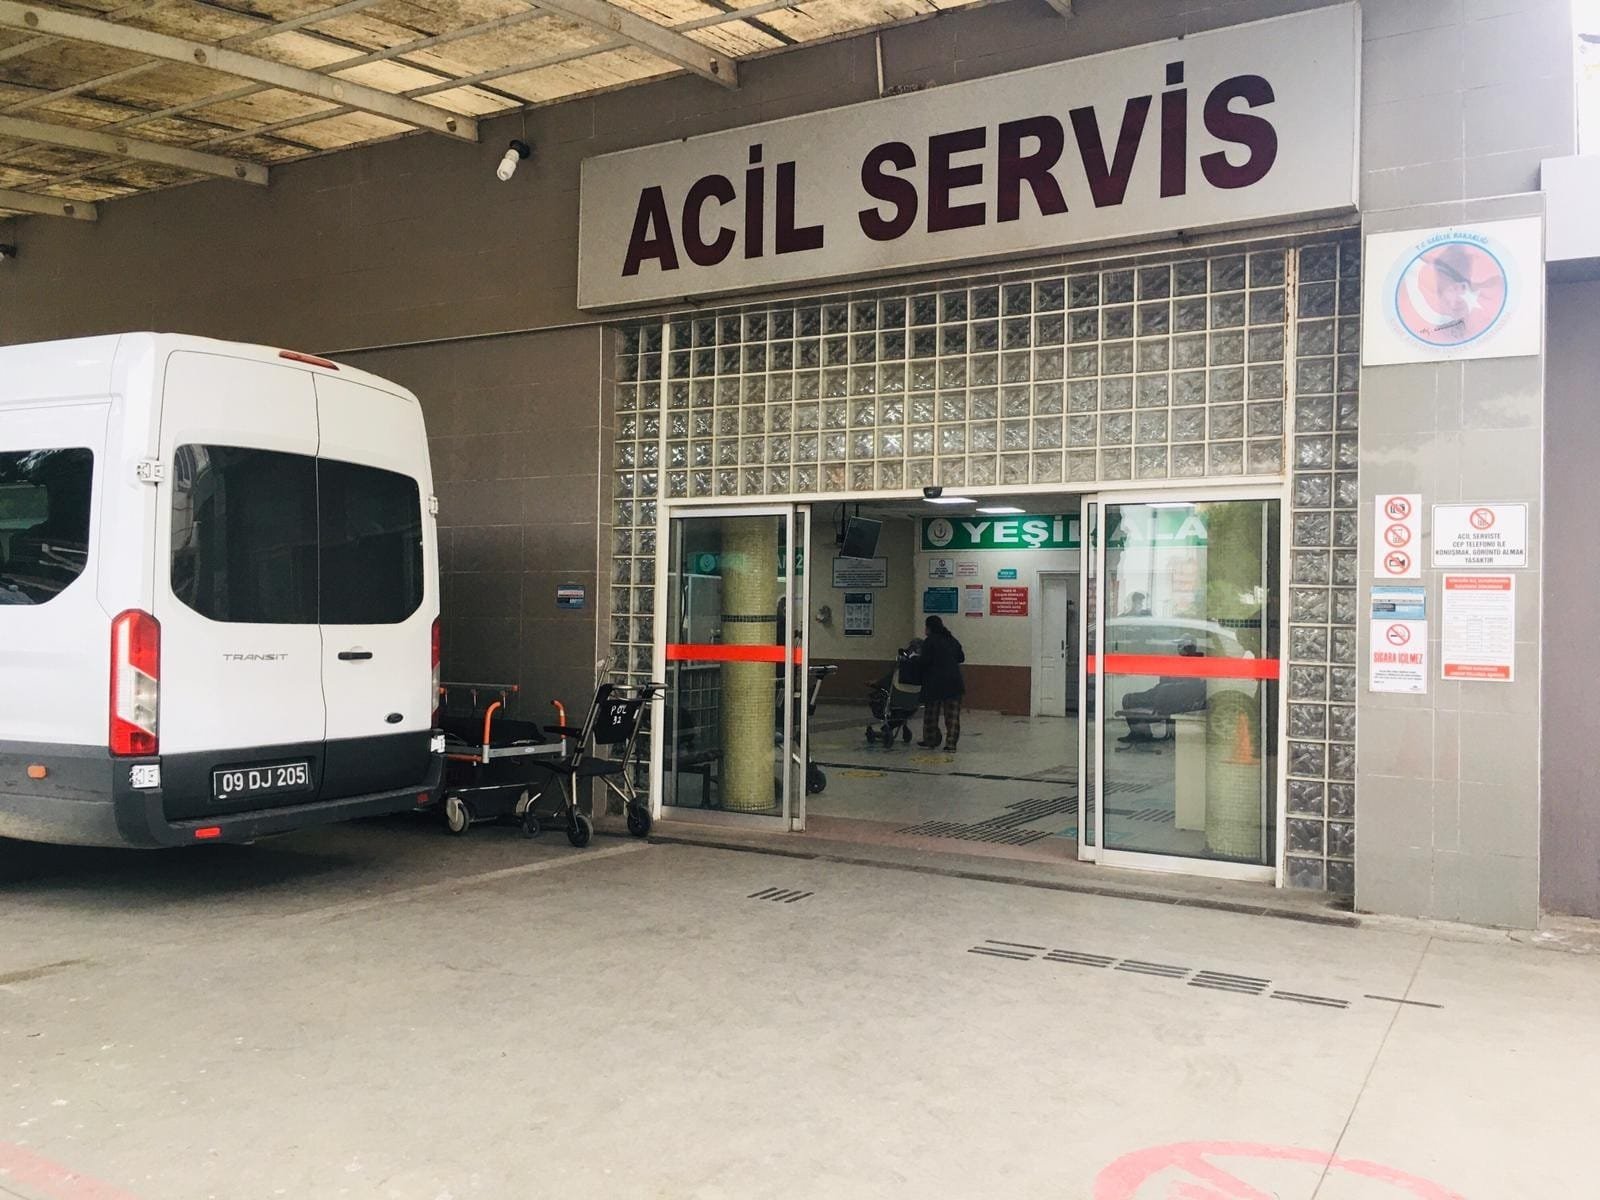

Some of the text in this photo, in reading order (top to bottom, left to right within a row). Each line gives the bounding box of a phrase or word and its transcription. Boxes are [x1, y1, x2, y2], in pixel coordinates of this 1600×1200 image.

[622, 61, 1279, 277] ACİL SERVİS
[222, 653, 289, 662] TRANSIT
[222, 766, 306, 792] 09 DJ 205
